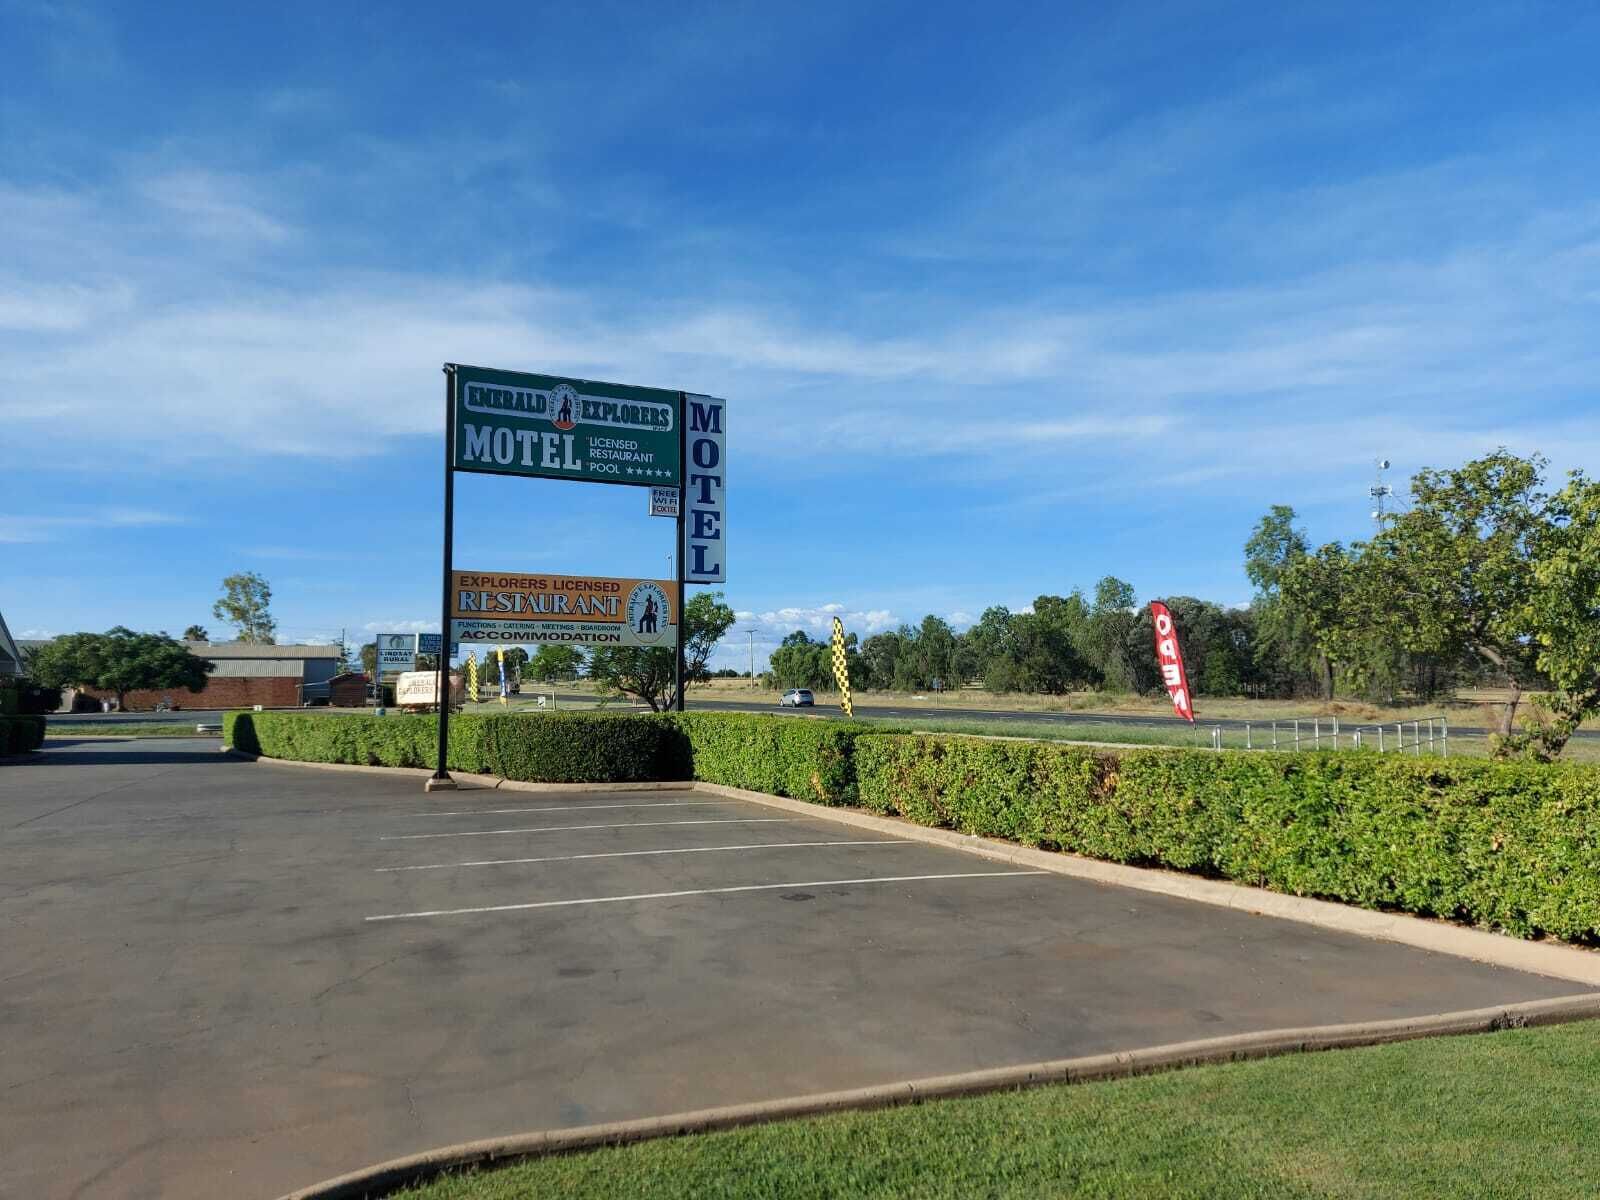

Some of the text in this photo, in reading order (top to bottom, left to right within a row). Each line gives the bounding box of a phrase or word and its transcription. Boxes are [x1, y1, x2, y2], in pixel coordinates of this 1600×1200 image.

[467, 385, 547, 413] EMERALD
[581, 399, 670, 426] EXPLORERS
[463, 423, 582, 471] MOTEL
[589, 437, 638, 450] LICENSED
[589, 449, 654, 463] RESTAURANT
[589, 462, 620, 475] POOL
[653, 489, 677, 498] FREE
[690, 402, 723, 576] MOTEL
[460, 576, 621, 593] EXPLORERS LICENSED
[458, 590, 622, 617] RESTAURANT
[458, 622, 497, 630] FUNCTIONS
[460, 630, 621, 642] ACCOMMODATION
